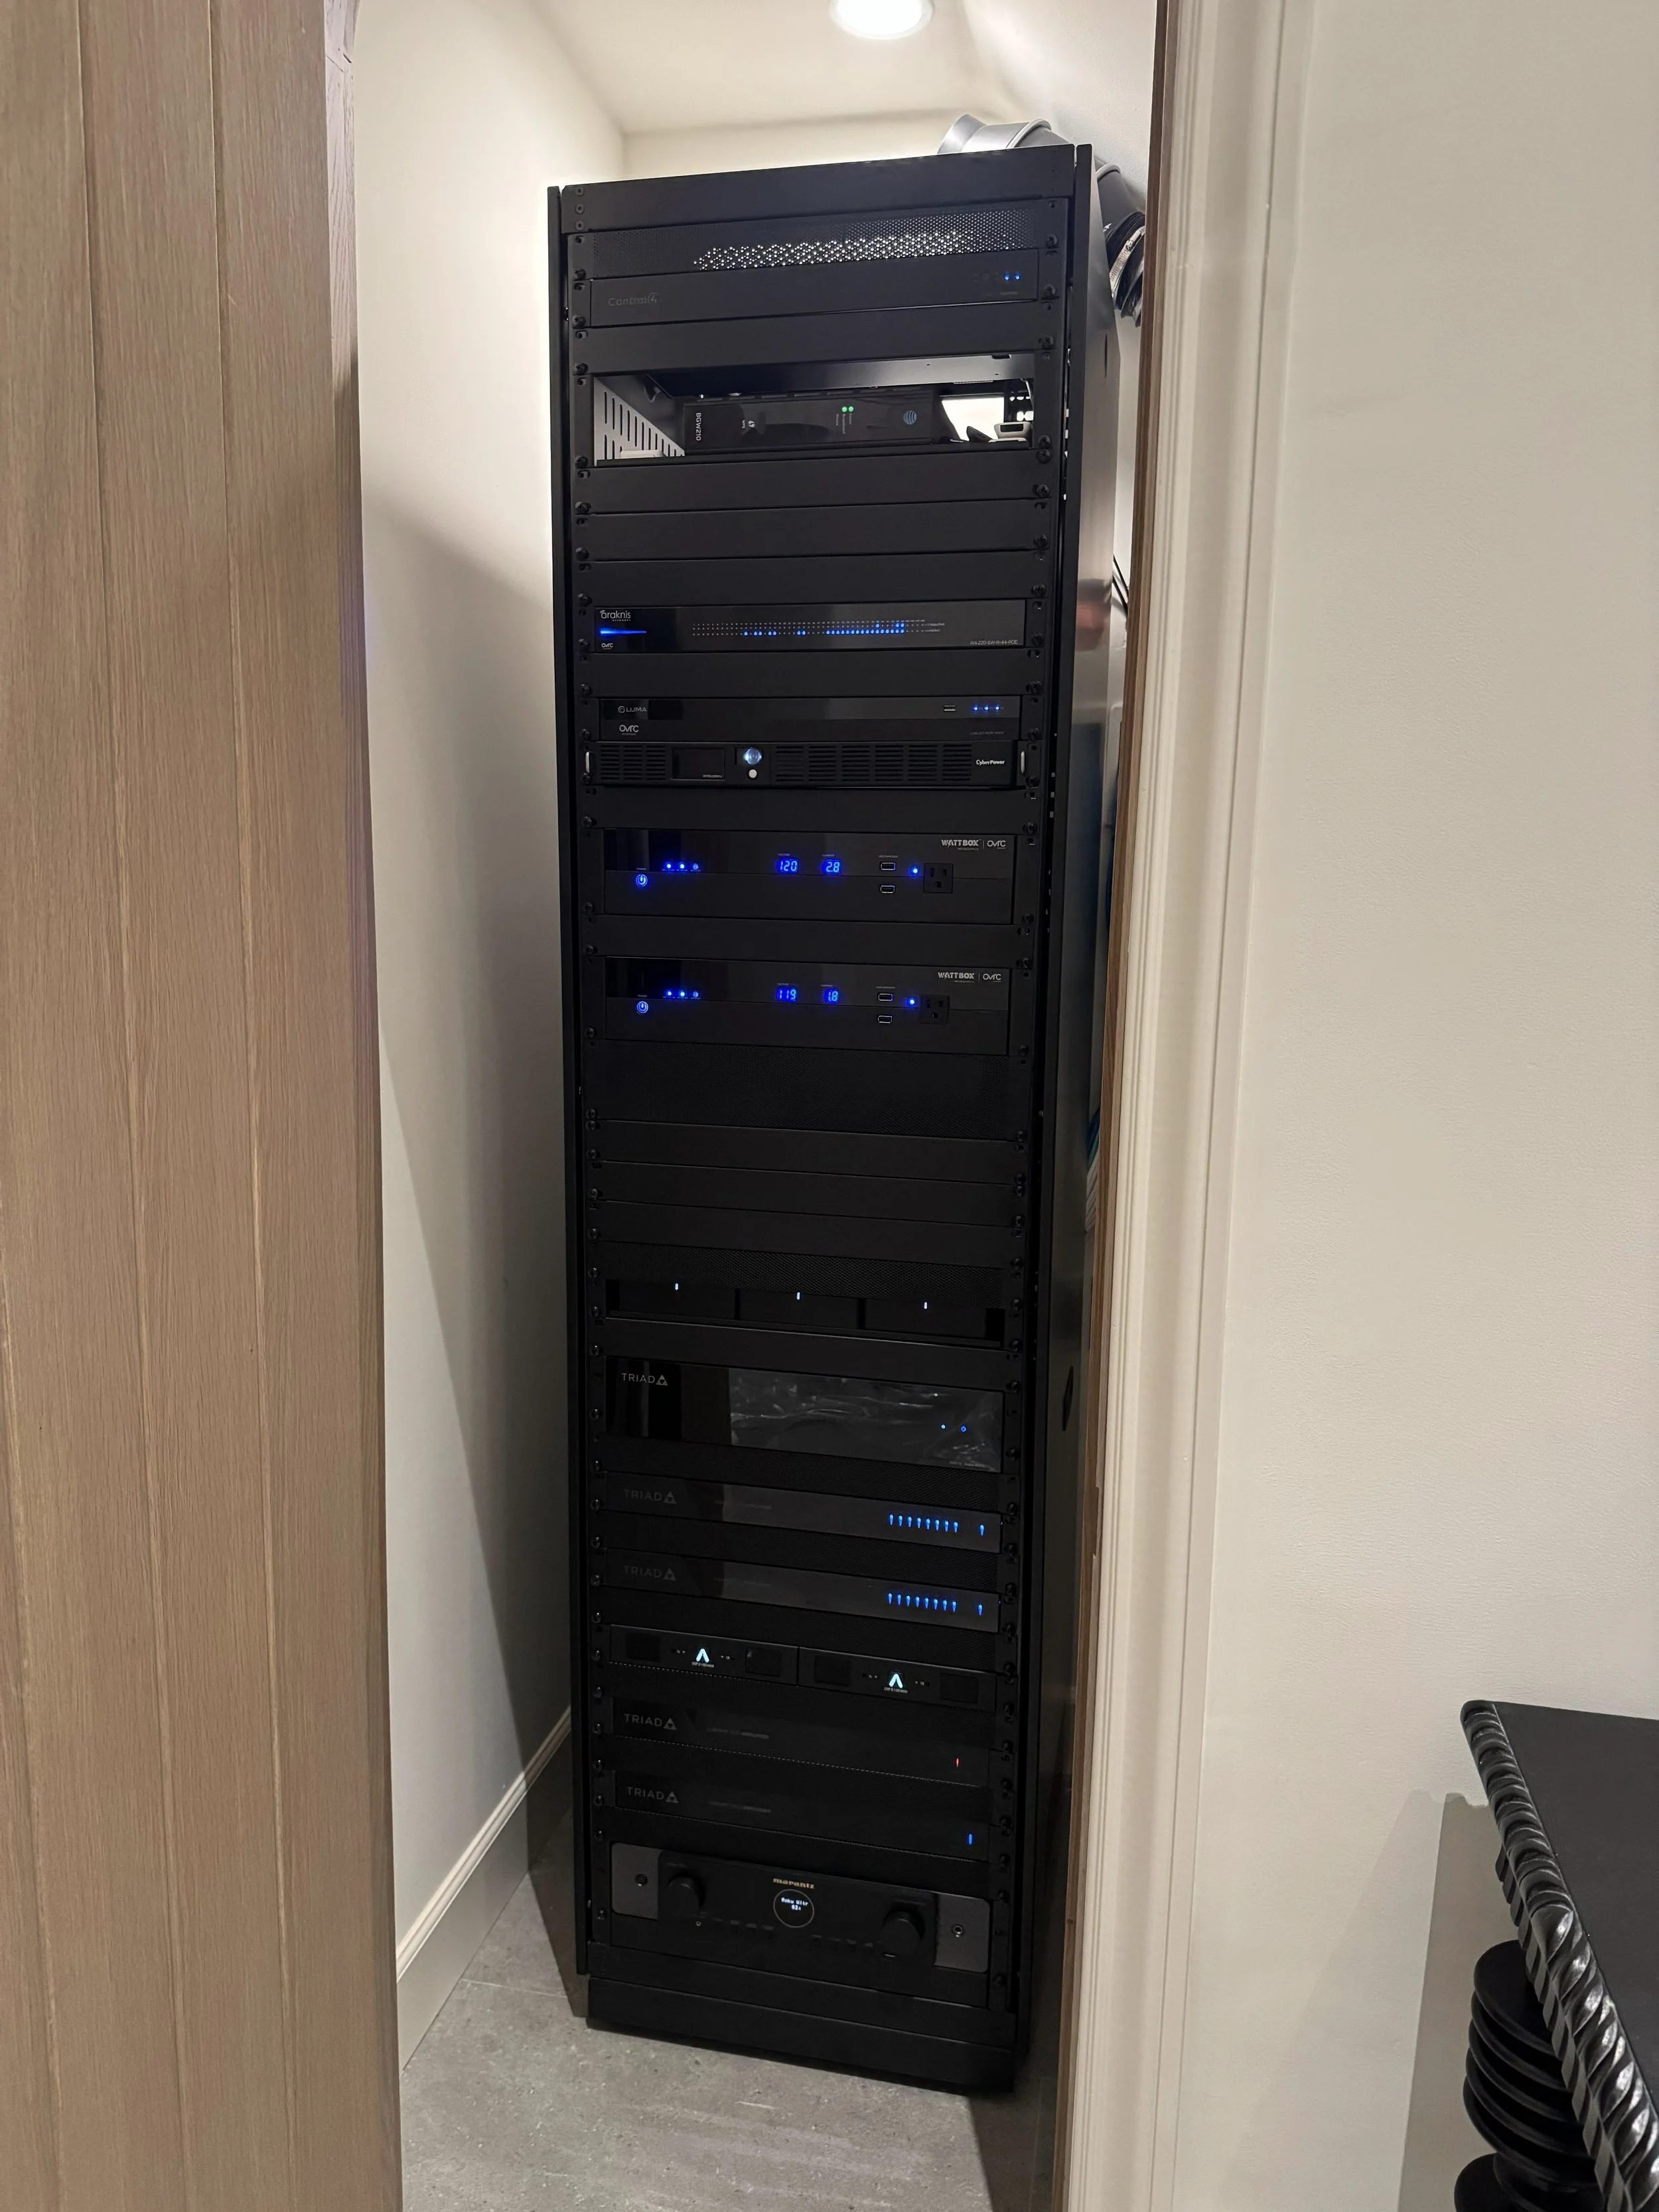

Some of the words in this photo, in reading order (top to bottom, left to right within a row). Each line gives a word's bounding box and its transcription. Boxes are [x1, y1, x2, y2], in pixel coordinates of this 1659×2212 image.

[601, 610, 632, 619] araknis
[780, 860, 798, 872] 120
[779, 989, 796, 1000] 119
[621, 1372, 656, 1384] TRIAD
[624, 1489, 662, 1502] TRIAD
[623, 1565, 662, 1578] TRIAD
[624, 1713, 663, 1727] TRIAD
[626, 1786, 664, 1800] TRIAD
[772, 1878, 815, 1889] marantz
